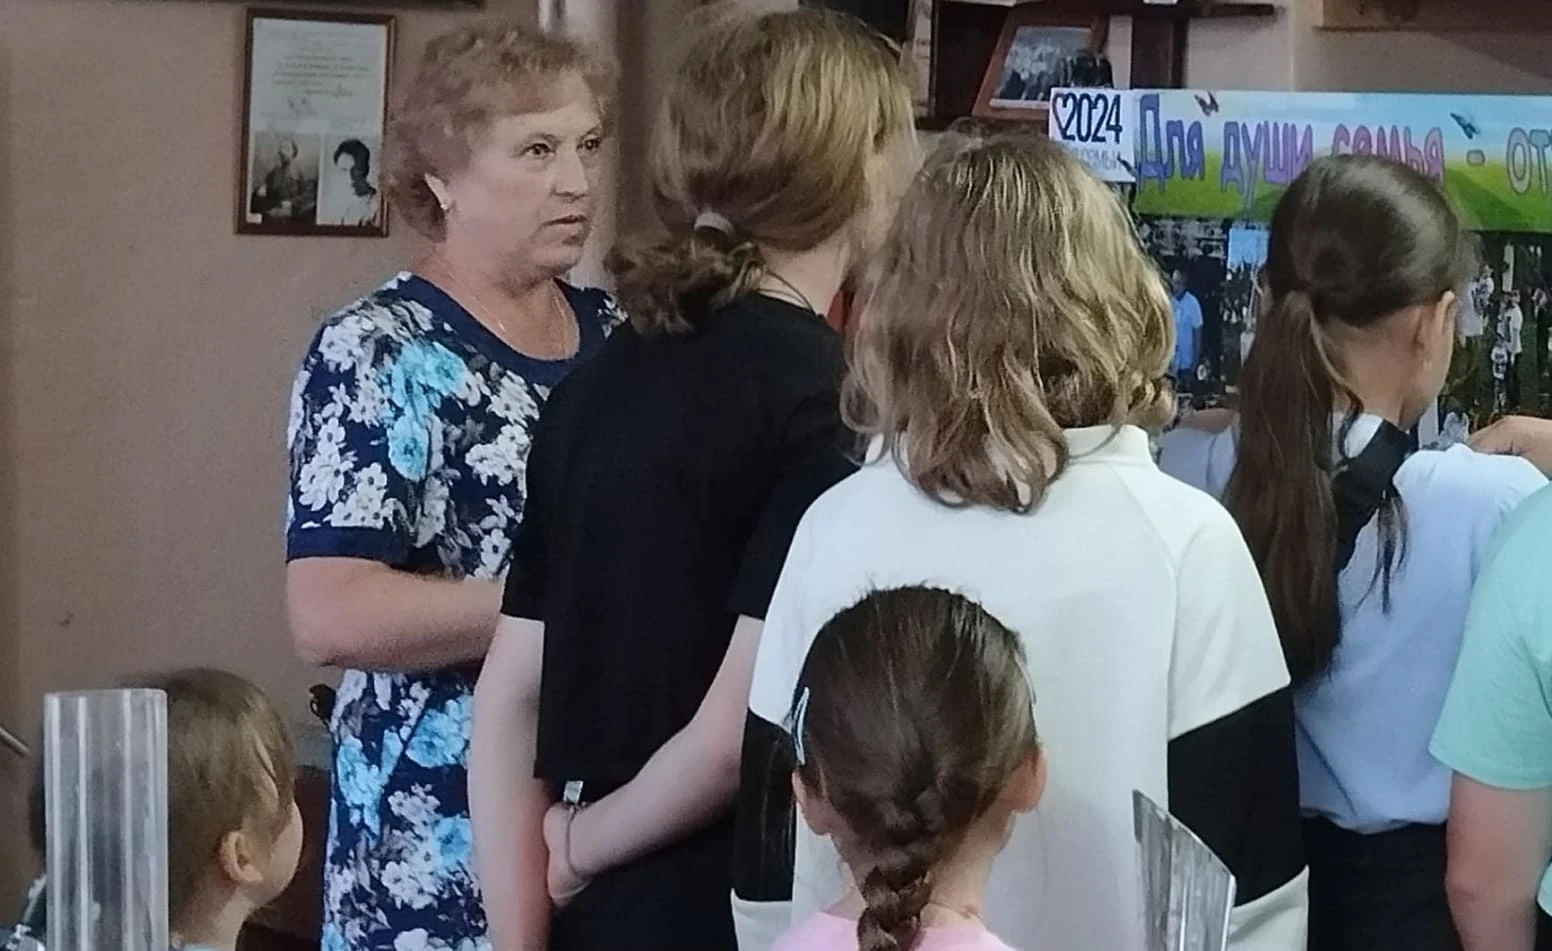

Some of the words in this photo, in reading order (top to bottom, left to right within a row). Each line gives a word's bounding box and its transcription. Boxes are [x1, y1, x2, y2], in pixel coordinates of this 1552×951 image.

[1061, 92, 1123, 144] 2024
[1137, 94, 1205, 193] Для
[1221, 120, 1313, 211] души
